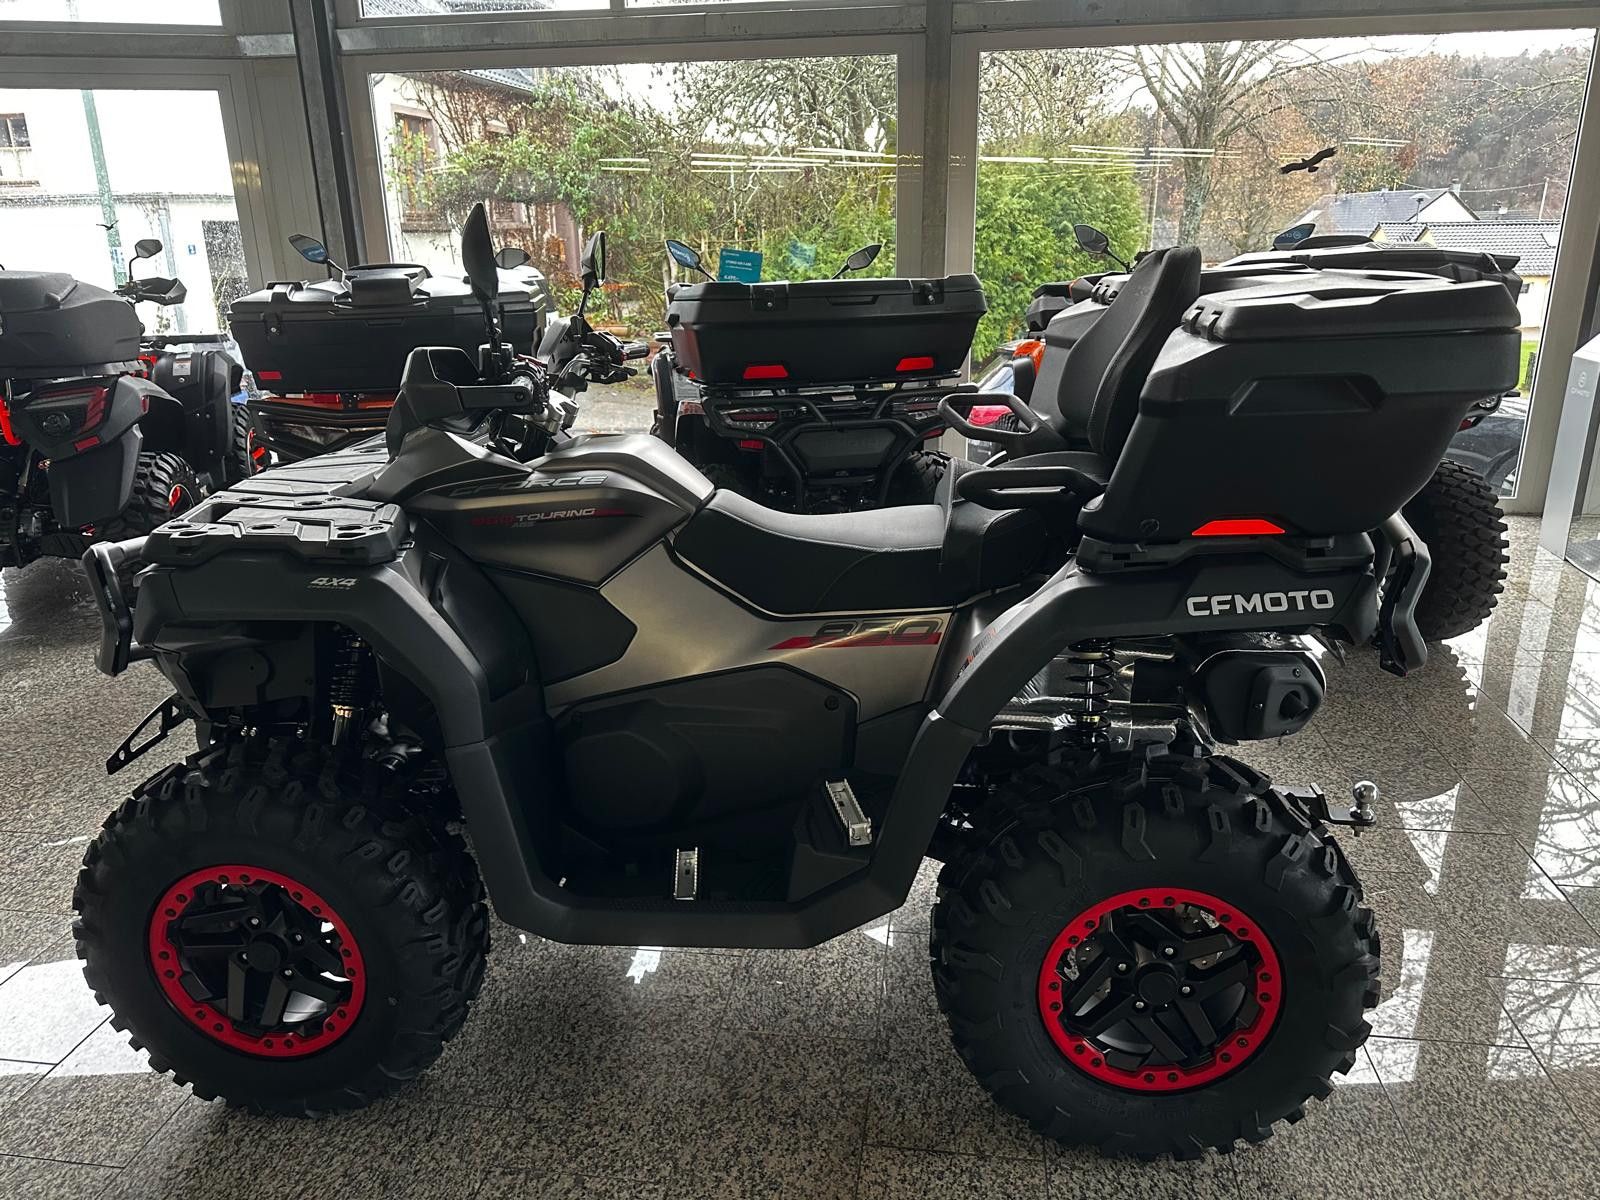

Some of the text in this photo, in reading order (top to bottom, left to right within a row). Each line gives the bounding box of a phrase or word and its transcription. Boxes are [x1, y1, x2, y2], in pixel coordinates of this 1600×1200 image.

[448, 474, 609, 497] CFORCE
[515, 507, 596, 521] TOURING
[1186, 589, 1335, 617] CFMOTO
